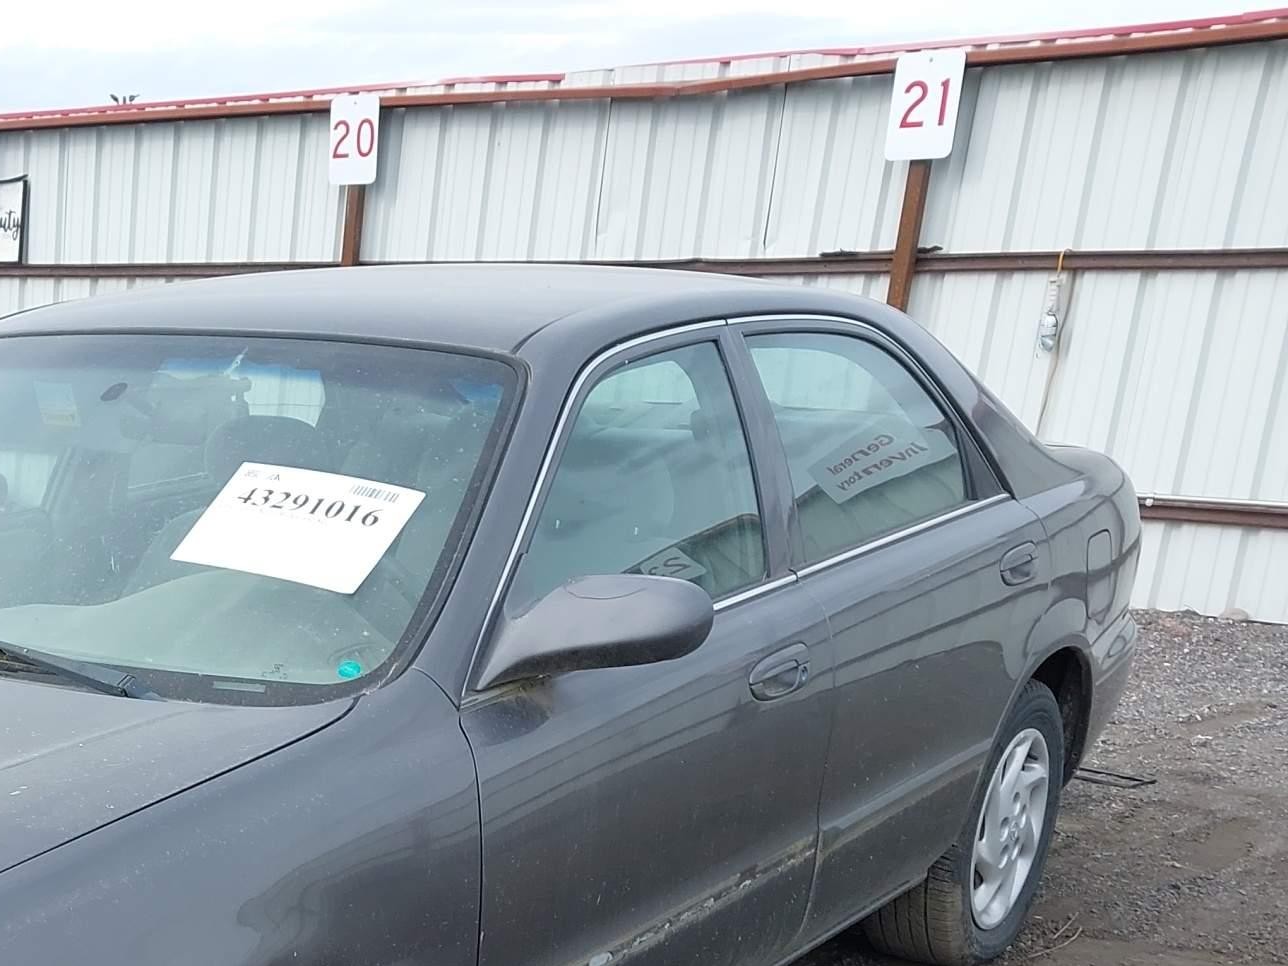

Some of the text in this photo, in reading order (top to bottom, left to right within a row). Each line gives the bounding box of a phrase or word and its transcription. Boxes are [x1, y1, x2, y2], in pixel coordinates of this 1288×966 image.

[898, 77, 952, 129] 21
[332, 118, 375, 159] 20
[237, 487, 384, 527] 43291016
